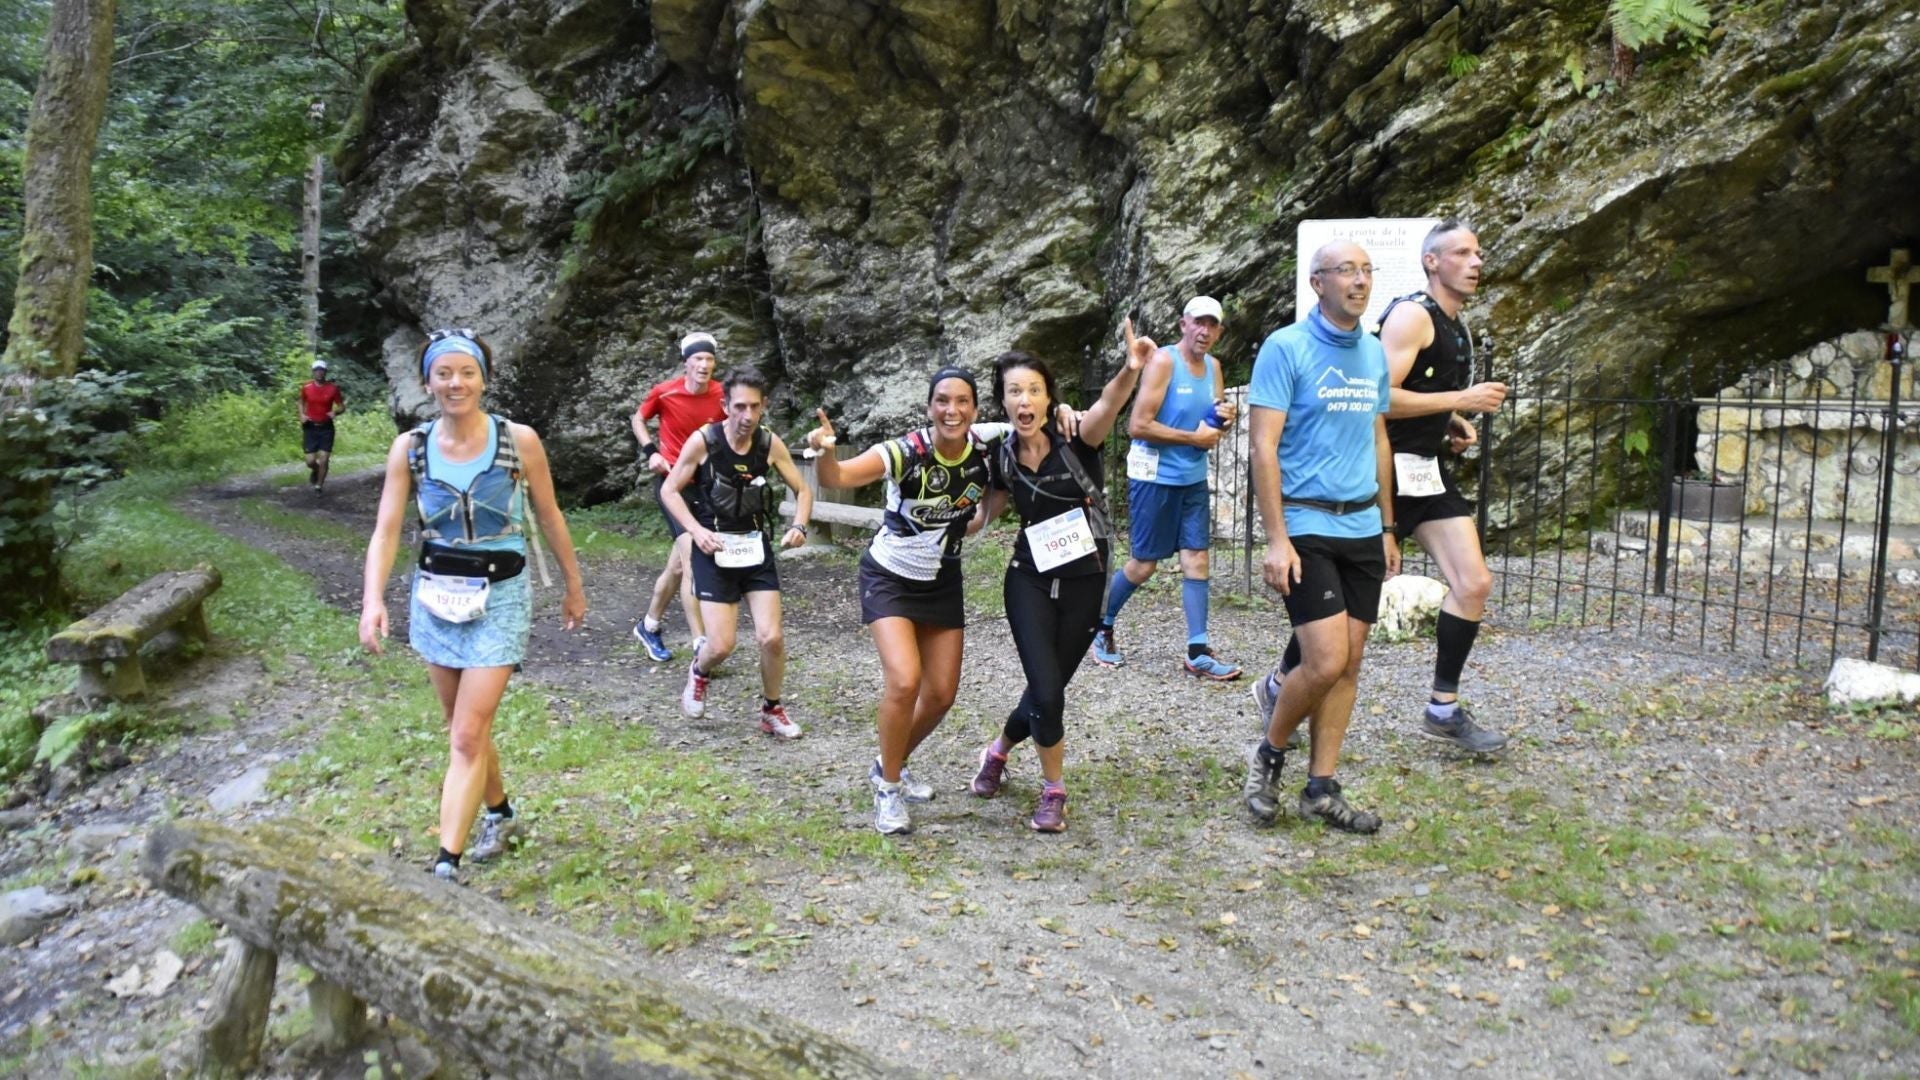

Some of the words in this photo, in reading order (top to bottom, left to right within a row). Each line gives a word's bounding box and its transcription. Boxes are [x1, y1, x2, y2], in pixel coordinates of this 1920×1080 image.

[1333, 227, 1344, 236] La
[1349, 228, 1376, 238] grotte
[1382, 227, 1392, 236] de
[1398, 227, 1407, 236] la
[1045, 531, 1080, 552] 19019
[435, 594, 471, 606] 19113
